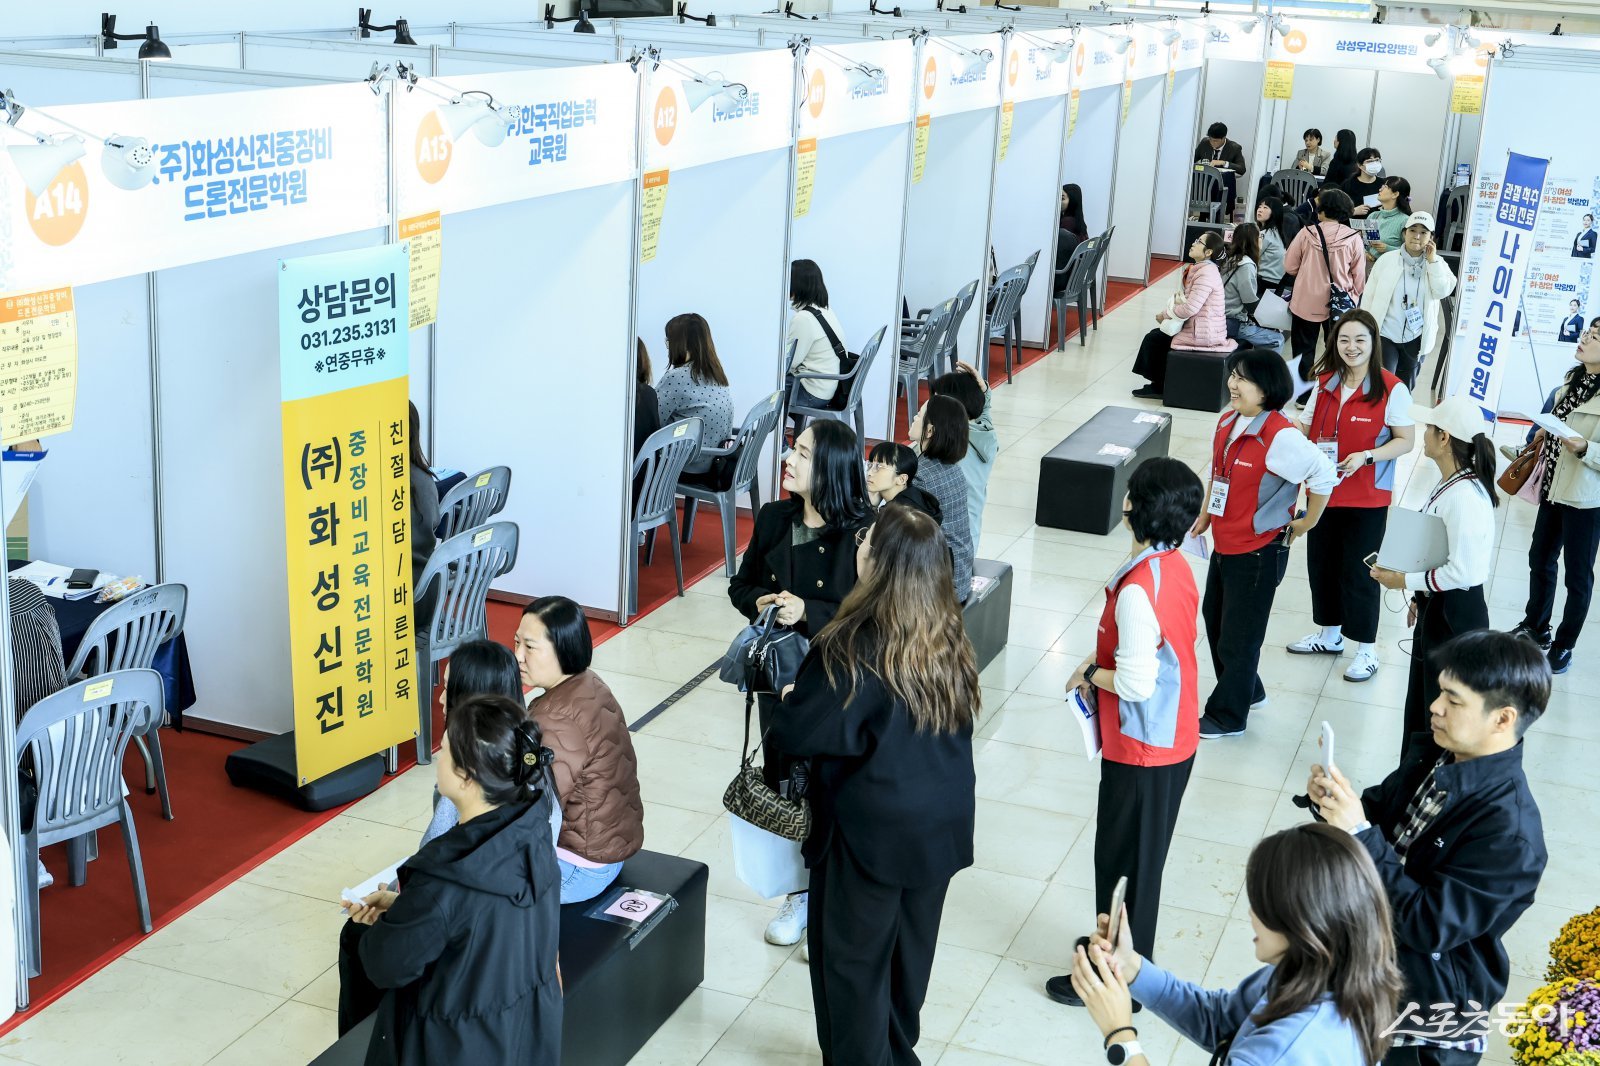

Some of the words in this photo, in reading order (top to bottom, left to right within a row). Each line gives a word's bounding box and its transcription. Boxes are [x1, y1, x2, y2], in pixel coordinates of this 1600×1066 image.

[1336, 39, 1418, 56] 삼성우리요양병원
[657, 106, 675, 129] A12
[152, 126, 333, 185] (주)화성신진중장비
[418, 136, 449, 163] A13
[529, 132, 567, 165] 교육원
[33, 181, 83, 220] A14
[184, 168, 308, 222] 드론전문학원
[1504, 182, 1523, 203] 관절
[1522, 186, 1540, 207] 척추
[1567, 197, 1590, 207] 박람회
[1516, 206, 1536, 226] 진료
[297, 272, 396, 323] 상담문의
[1554, 283, 1577, 292] 박람회
[1469, 230, 1520, 401] 나이스병원
[300, 317, 396, 351] 031.235.3131
[348, 430, 374, 719] 중장비교육전문학원
[390, 420, 410, 700] 친절상담/바른교육
[301, 436, 346, 735] (주)화성신진
